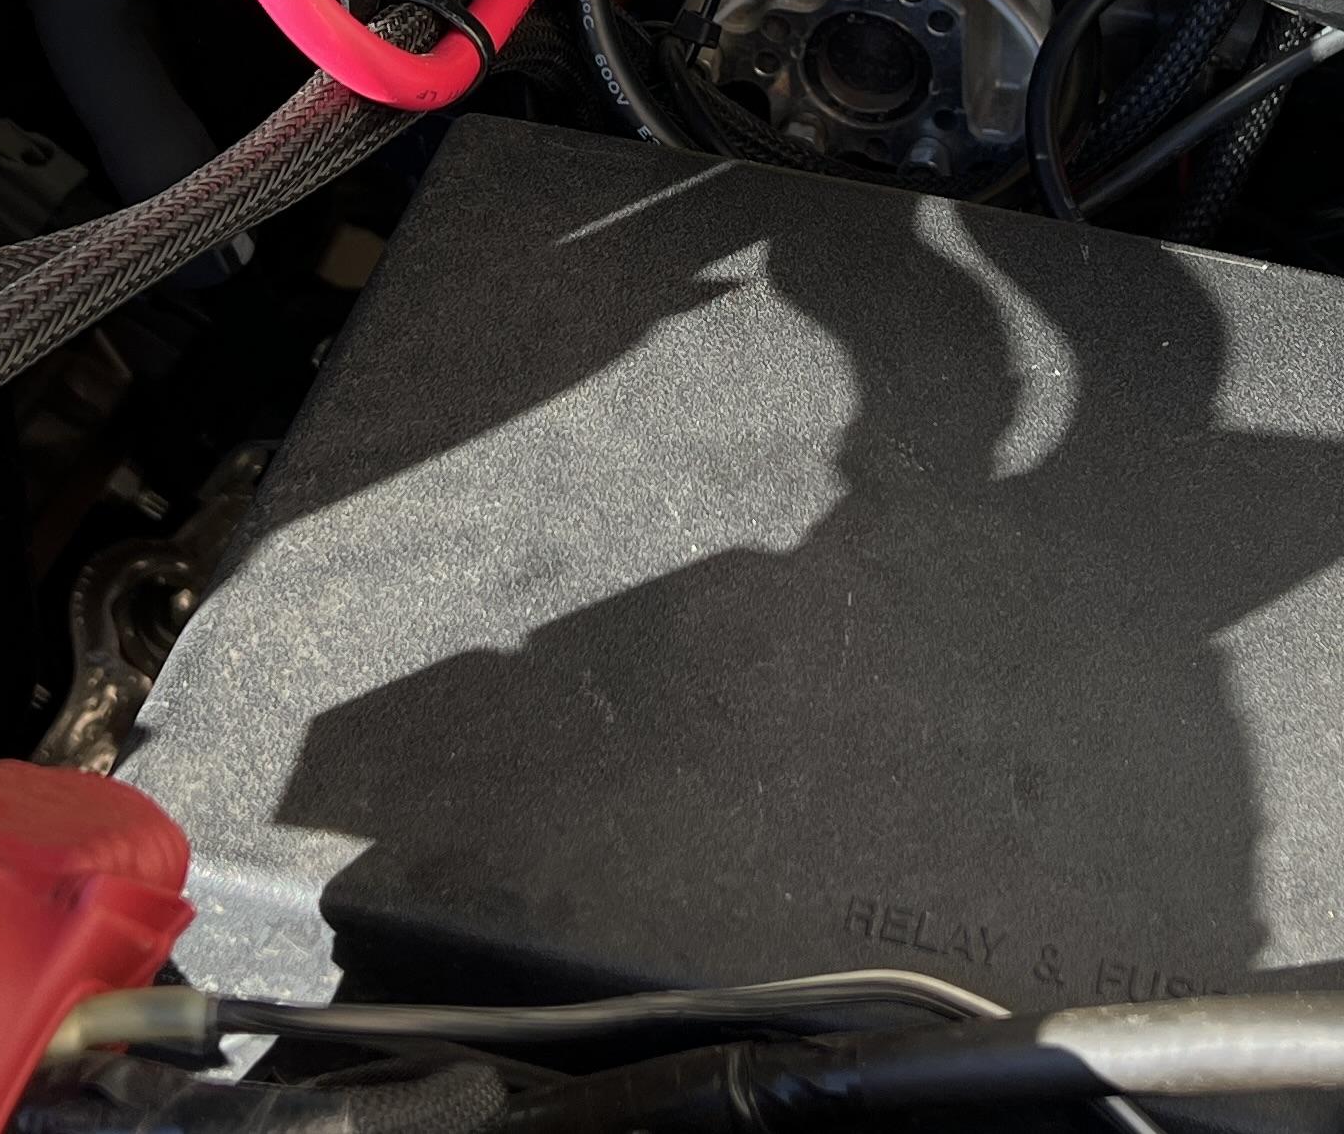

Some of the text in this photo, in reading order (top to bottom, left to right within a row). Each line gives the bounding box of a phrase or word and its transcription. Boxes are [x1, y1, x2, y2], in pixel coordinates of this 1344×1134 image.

[593, 53, 631, 106] 600V
[843, 894, 1008, 966] RELAY
[1032, 944, 1066, 987] &
